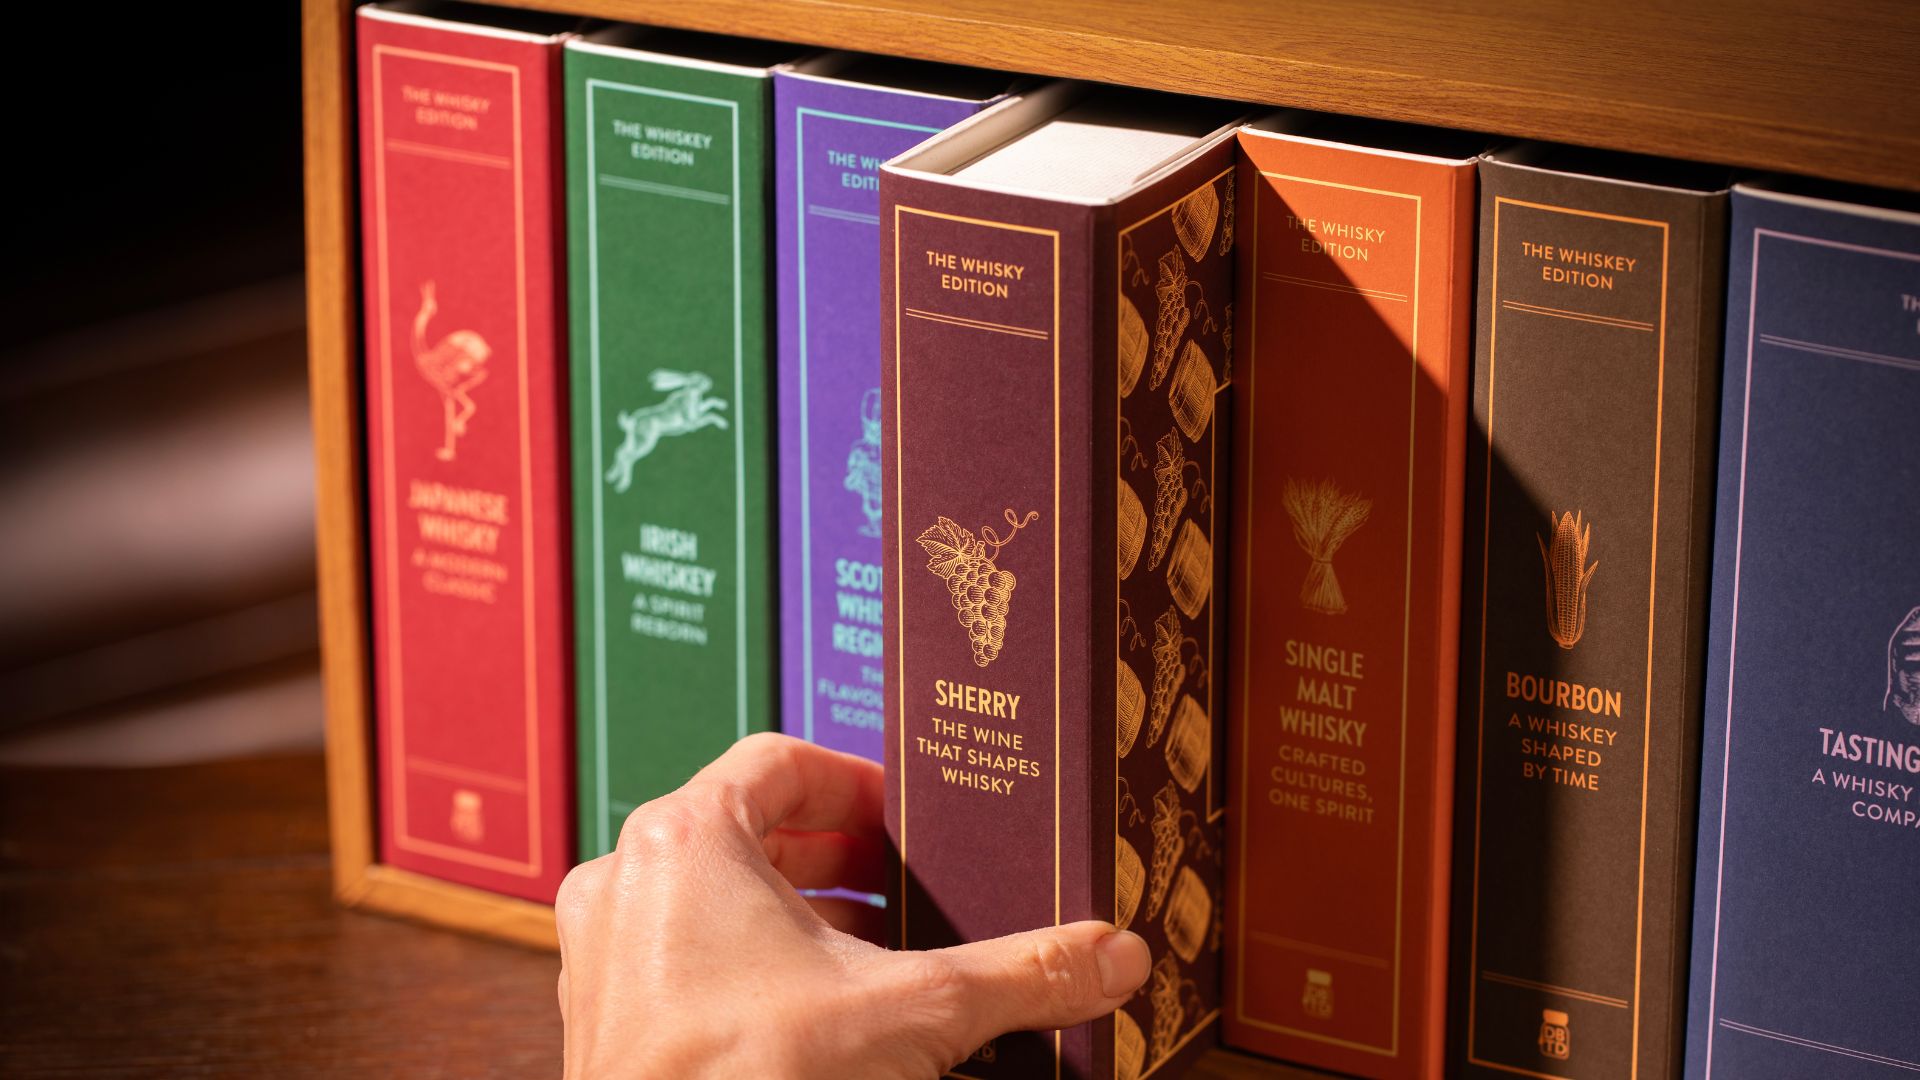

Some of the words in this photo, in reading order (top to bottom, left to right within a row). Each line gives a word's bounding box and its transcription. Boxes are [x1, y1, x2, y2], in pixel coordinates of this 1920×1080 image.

[402, 85, 430, 105] THE
[416, 107, 477, 131] EDITION
[613, 120, 642, 139] THE
[645, 125, 712, 150] WHISKEY
[631, 142, 694, 166] EDITION
[827, 150, 856, 168] THE
[1286, 216, 1317, 233] THE
[1322, 220, 1386, 244] WHISKY
[926, 251, 957, 270] THE
[961, 257, 1024, 280] WHISKY
[1301, 239, 1368, 262] EDITION
[1522, 241, 1554, 261] THE
[1559, 247, 1636, 273] WHISKEY
[942, 274, 1008, 299] EDITION
[1542, 266, 1613, 291] EDITION
[407, 480, 509, 526] JAPANESE
[417, 513, 500, 555] WHISKY
[640, 524, 697, 561] IRISH
[621, 551, 717, 597] WHISKEY
[632, 592, 647, 611] A
[648, 594, 704, 621] SPIRIT
[631, 612, 708, 645] REBORN
[1285, 640, 1364, 680] SINGLE
[935, 679, 1020, 720] SHERRY
[1297, 675, 1357, 711] MALT
[1506, 671, 1622, 719] BOURBON
[932, 717, 967, 740] THE
[973, 726, 1023, 751] WINE
[1279, 705, 1367, 748] WHISKY
[1508, 713, 1521, 729] A
[1528, 714, 1617, 747] WHISKEY
[917, 736, 962, 762] THAT
[967, 749, 1040, 777] SHAPES
[1279, 745, 1366, 776] CRAFTED
[1521, 738, 1602, 768] SHAPED
[1819, 727, 1920, 773] TASTING
[941, 766, 1015, 796] WHISKY
[1271, 766, 1373, 804] CULTURES,
[1523, 761, 1547, 780] BY
[1552, 766, 1599, 791] TIME
[1811, 767, 1826, 785] A
[1832, 770, 1914, 803] WHISKY
[1268, 788, 1311, 813] ONE
[1315, 798, 1375, 825] SPIRIT
